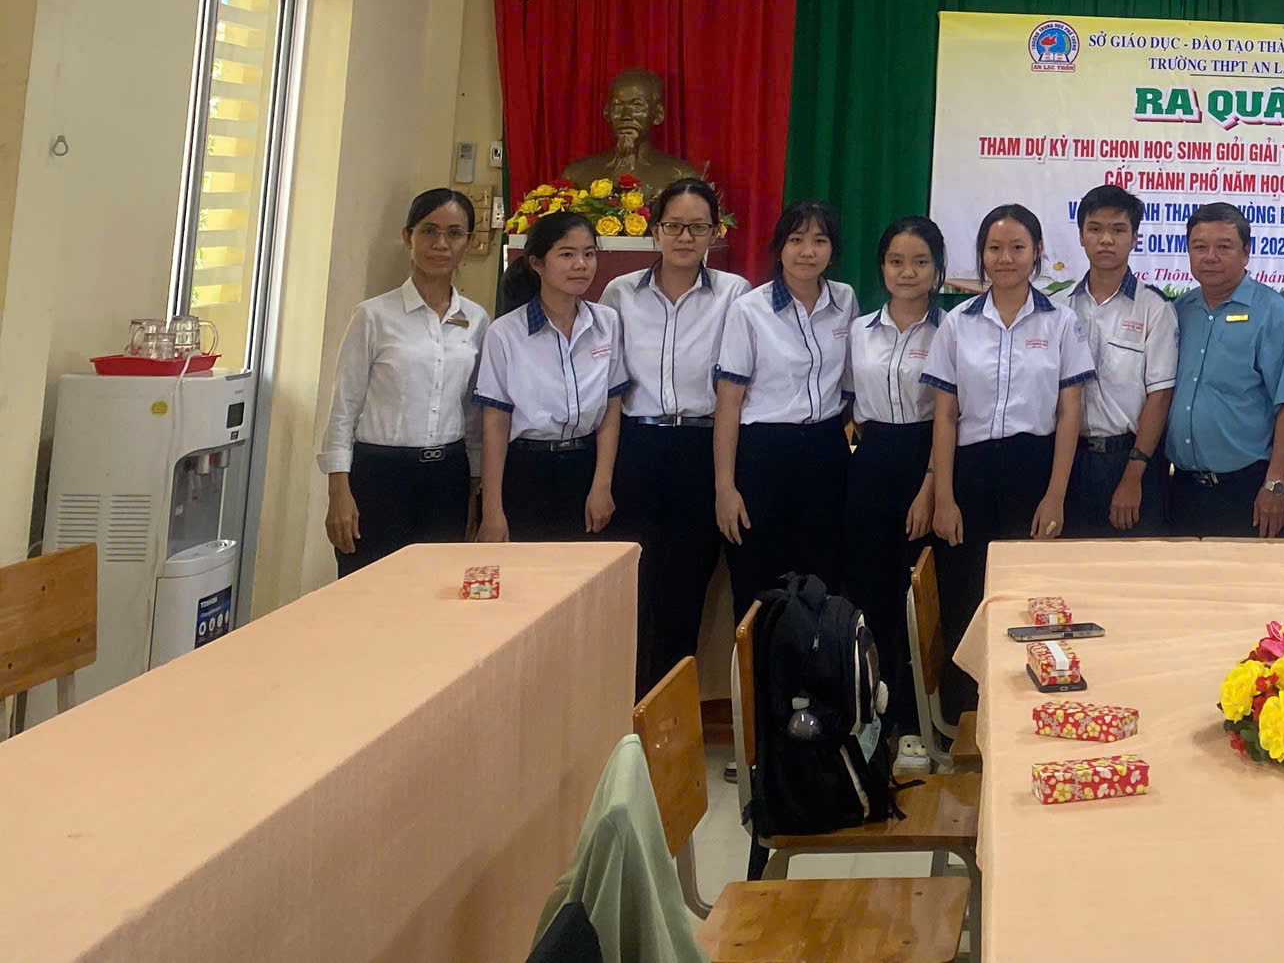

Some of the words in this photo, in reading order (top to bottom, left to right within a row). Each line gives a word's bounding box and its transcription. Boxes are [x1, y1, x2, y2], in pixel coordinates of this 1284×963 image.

[1088, 30, 1107, 48] SỞ
[1110, 32, 1147, 49] GIÁO
[1150, 36, 1181, 52] DỤC
[1192, 35, 1222, 51] ĐÀO
[1225, 39, 1254, 54] TẠO
[1148, 55, 1207, 71] TRƯỜNG
[1210, 59, 1248, 73] THPT
[1251, 61, 1270, 74] AN
[1134, 87, 1196, 117] RA
[979, 137, 1021, 156] THAM
[1025, 135, 1047, 161] DỰ
[1049, 135, 1069, 157] KỲ
[1073, 139, 1096, 158] THI
[1100, 139, 1139, 162] CHỌN
[1144, 140, 1173, 163] HỌC
[1177, 140, 1213, 161] SINH
[1216, 135, 1245, 162] GIỎI
[1249, 137, 1278, 163] GIẢI
[1104, 165, 1134, 188] CẤP
[1138, 166, 1186, 191] THÀNH
[1189, 166, 1222, 192] PHỐ
[1223, 170, 1257, 193] NĂM
[1148, 234, 1187, 253] OLYM
[1153, 268, 1193, 284] Thôn,
